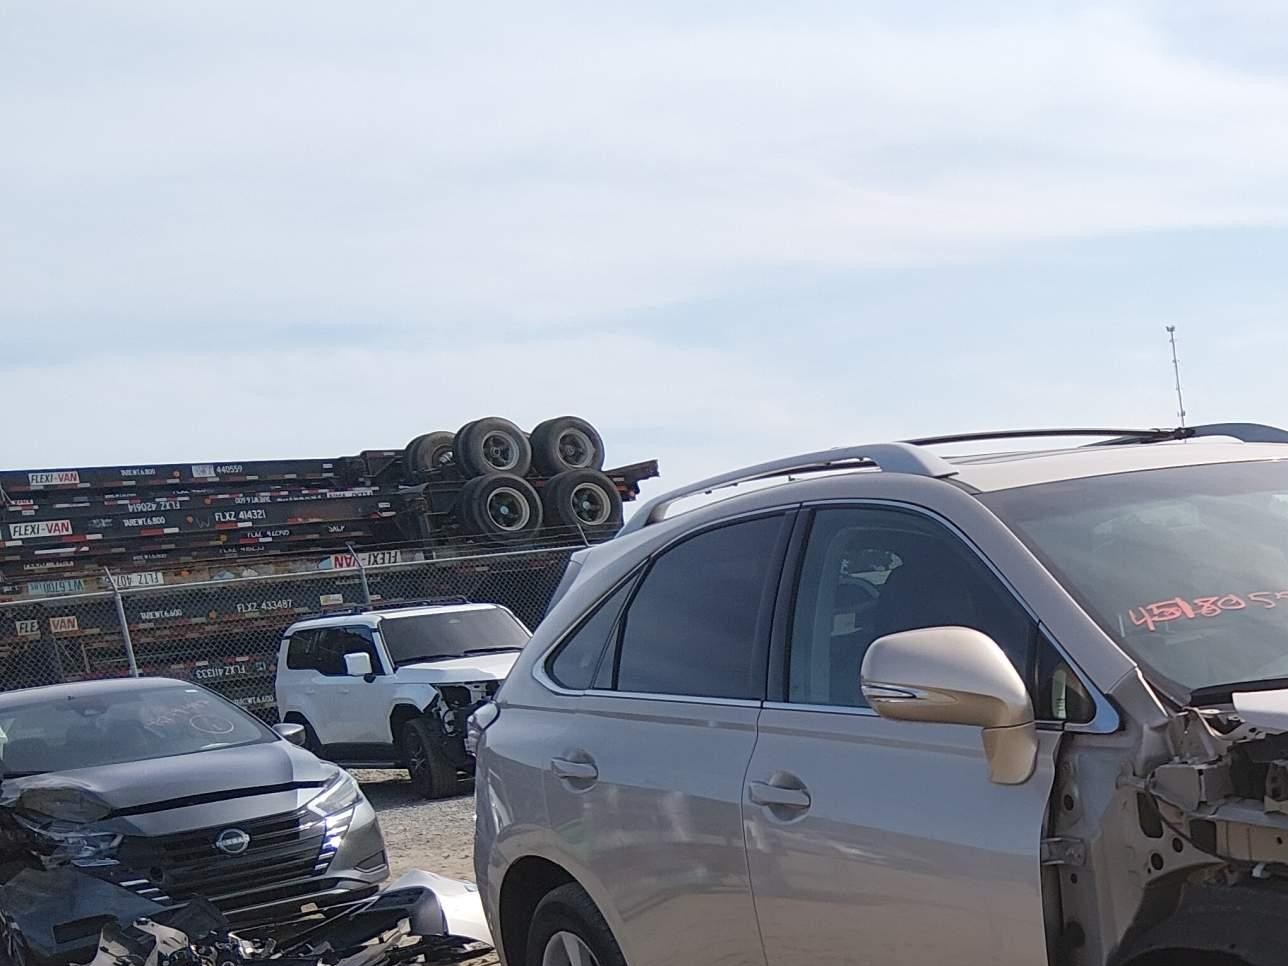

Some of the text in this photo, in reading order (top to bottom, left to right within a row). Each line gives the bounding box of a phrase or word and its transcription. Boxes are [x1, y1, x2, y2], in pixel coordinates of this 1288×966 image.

[216, 464, 243, 473] 440559
[31, 473, 77, 483] FLEXI-VAN
[128, 501, 180, 513] FLXZ 420614
[214, 509, 266, 522] FLXZ 414321
[13, 522, 70, 537] FLEXI-VAN
[237, 600, 292, 613] FLXZ 433487
[224, 665, 246, 676] FLXZ
